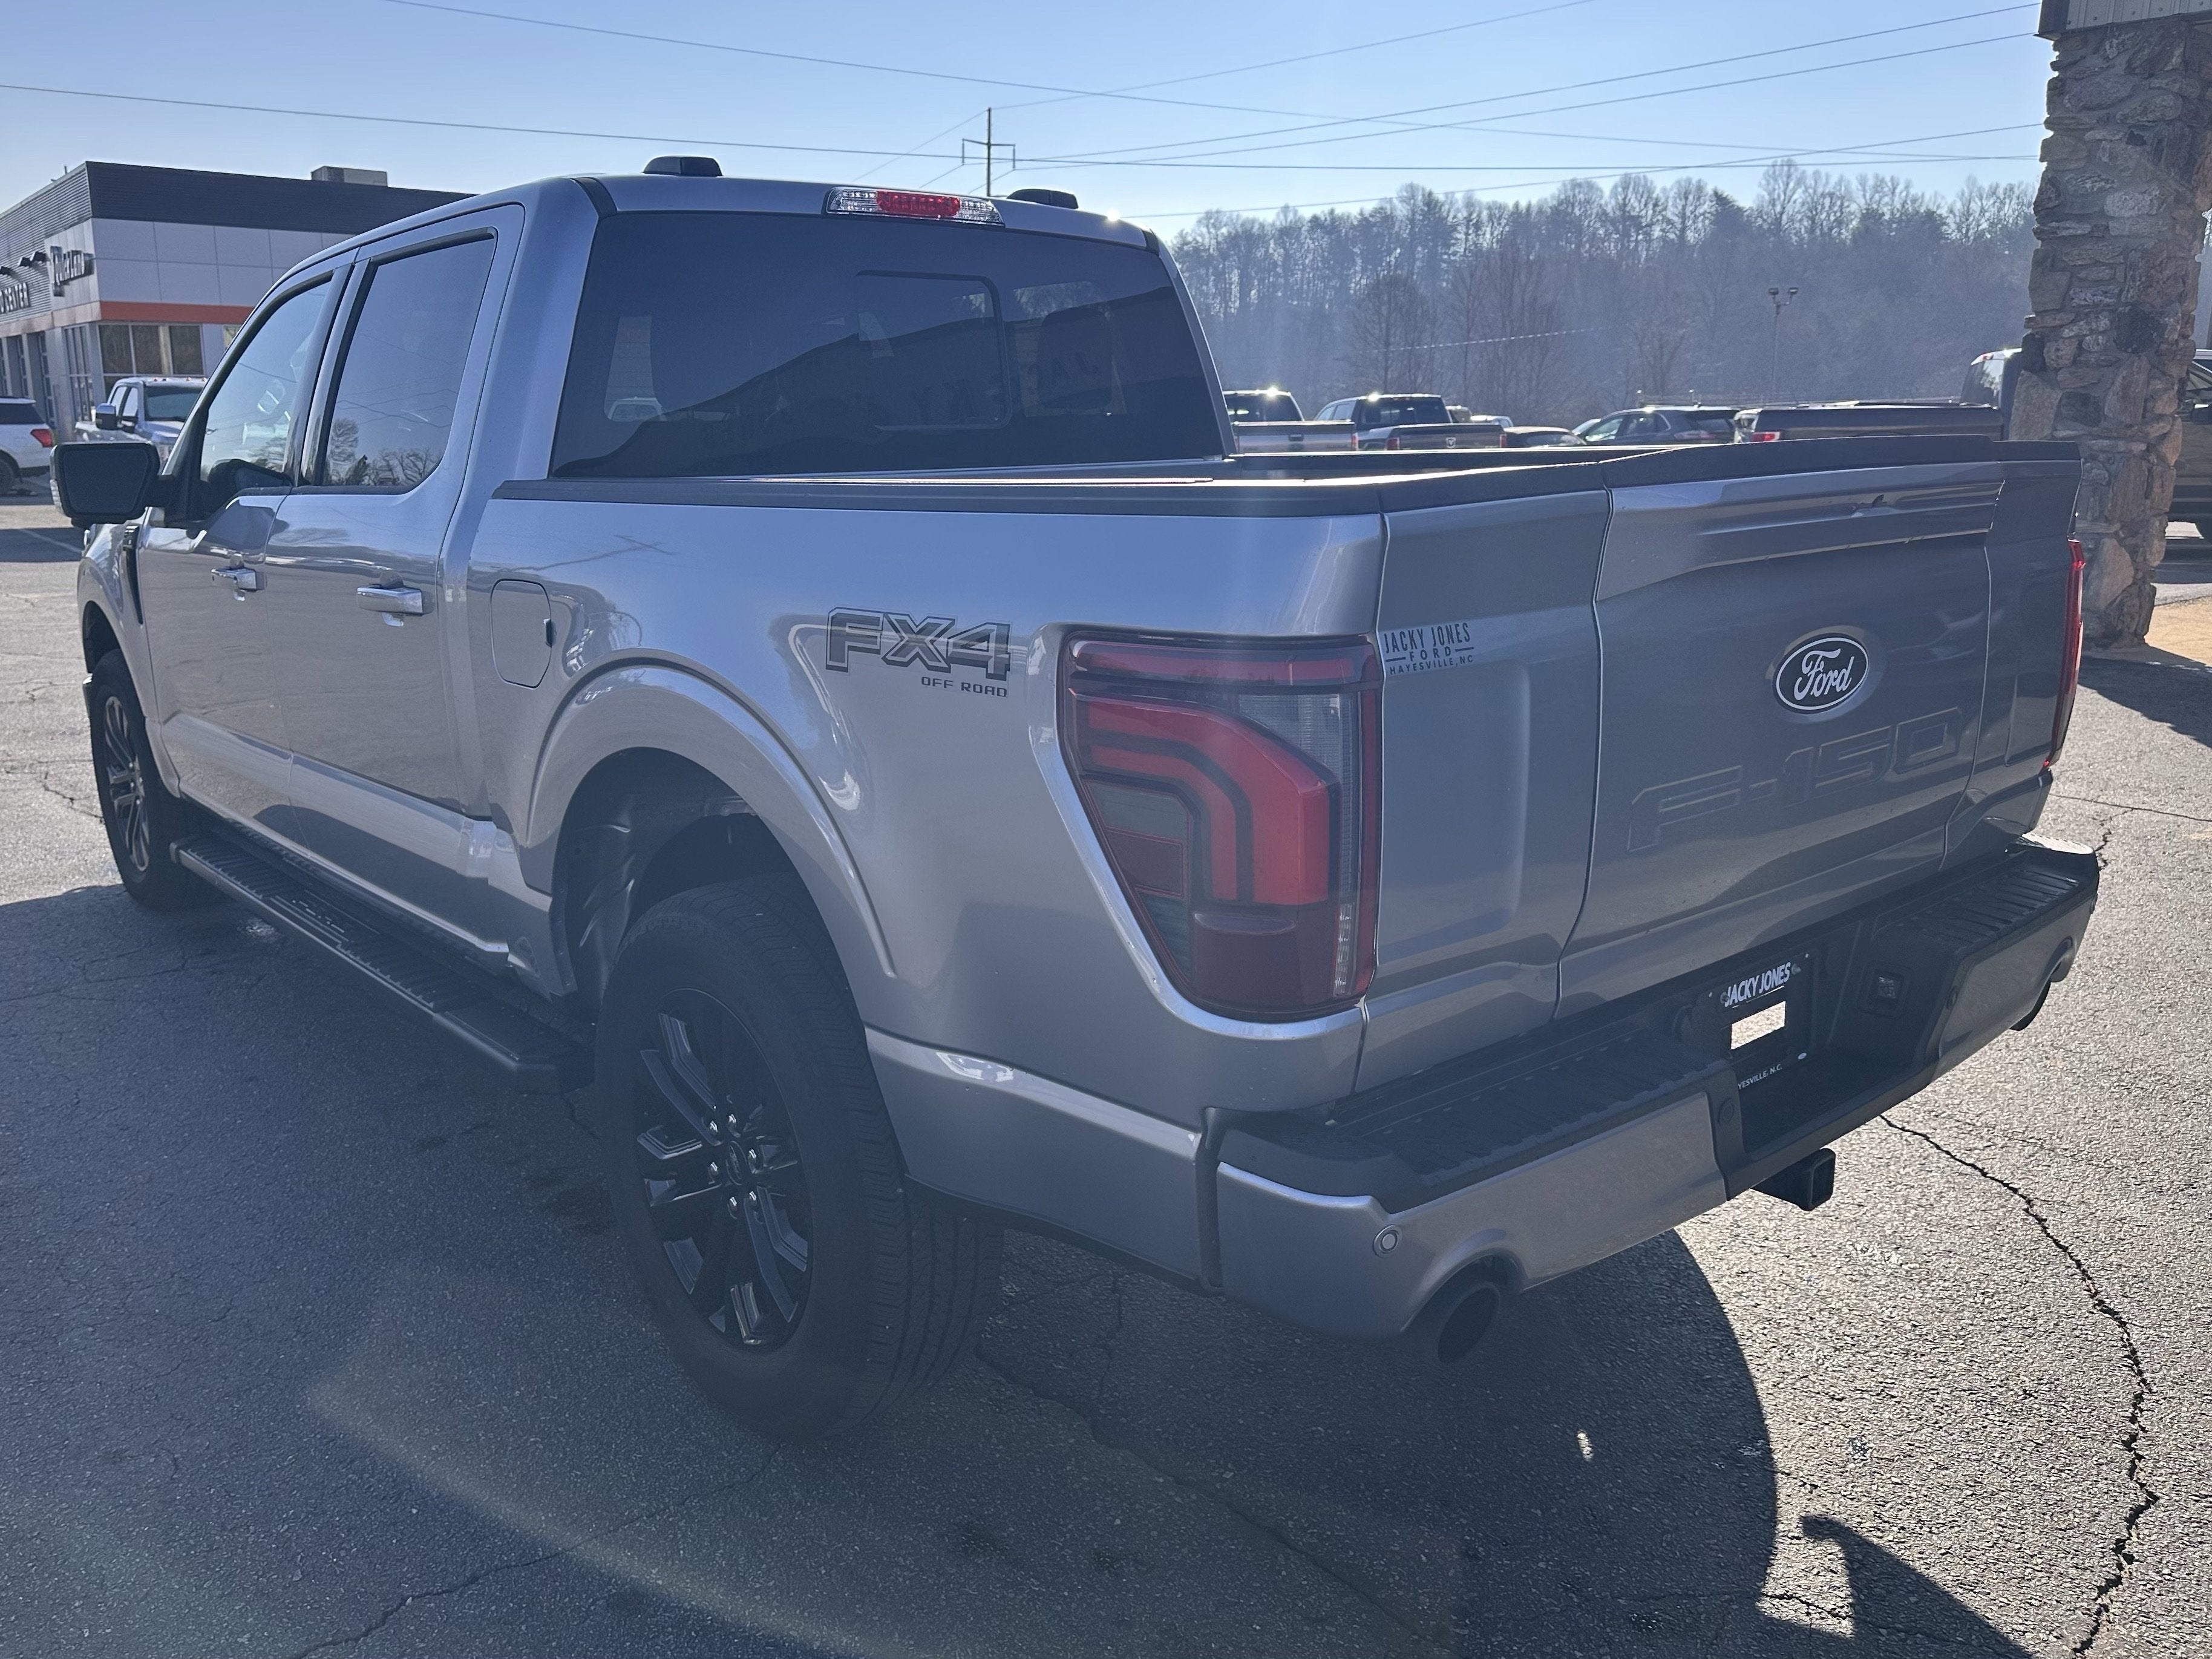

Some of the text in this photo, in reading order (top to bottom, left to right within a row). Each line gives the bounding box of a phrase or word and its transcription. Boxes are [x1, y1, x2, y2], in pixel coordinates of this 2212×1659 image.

[826, 606, 1011, 681] FX4
[1384, 622, 1471, 654] JACKY JONES
[1409, 646, 1451, 661] FORD
[921, 676, 1007, 697] OFF ROAD
[1793, 648, 1855, 701] Ford
[1628, 707, 1962, 852] F-150
[1724, 962, 1792, 1007] JACKY JONES
[1738, 1070, 1769, 1089] YESVILLE,
